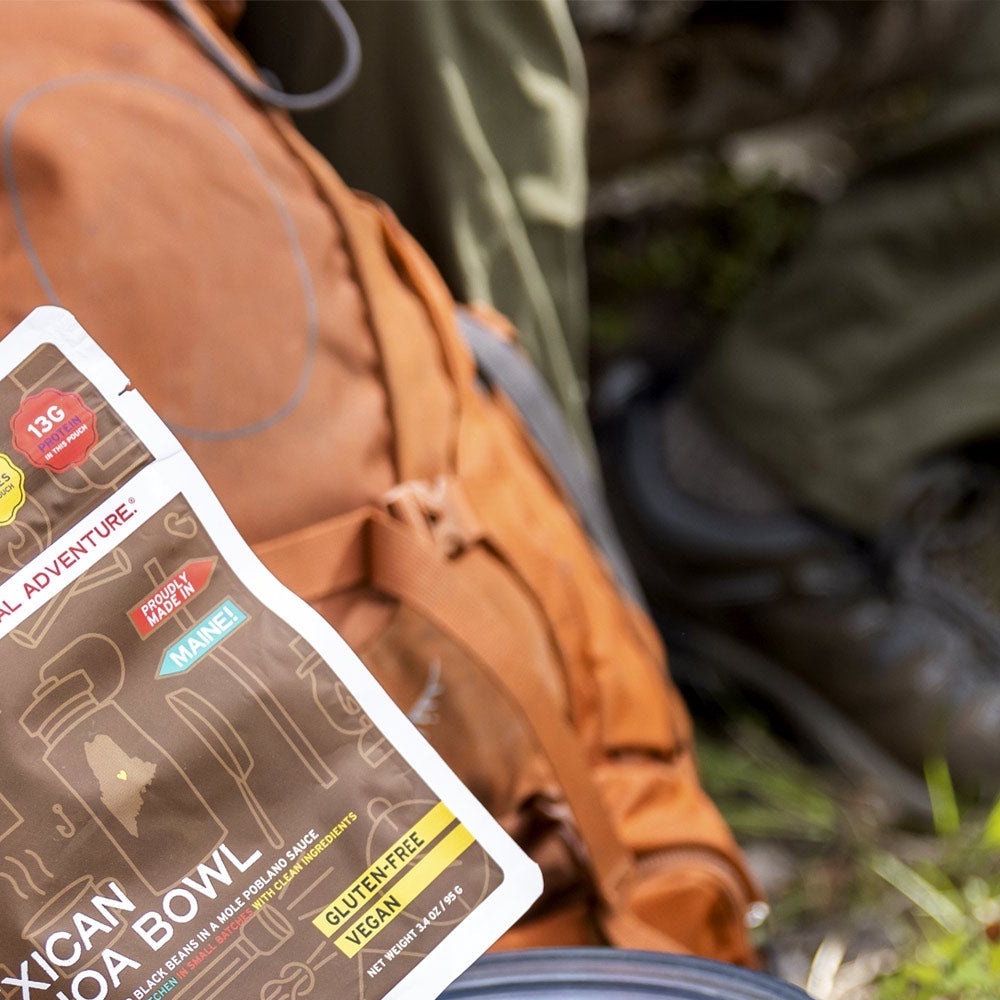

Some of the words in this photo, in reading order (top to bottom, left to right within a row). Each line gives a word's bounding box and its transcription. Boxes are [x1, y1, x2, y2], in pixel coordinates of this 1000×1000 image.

[27, 405, 65, 438] 13G
[37, 415, 82, 453] PROTEIN
[44, 452, 53, 461] IN
[52, 442, 68, 456] THIS
[66, 424, 88, 446] POUCH
[140, 571, 189, 617] PROUDLY
[146, 594, 182, 627] MADE
[180, 582, 195, 600] IN
[168, 605, 239, 668] MAINE!
[131, 843, 263, 951] BOWL
[176, 968, 188, 980] IN
[187, 943, 217, 970] SMALL
[214, 907, 255, 945] BATCHES
[251, 889, 276, 911] WITH
[273, 863, 303, 892] CLEAN
[300, 811, 358, 866] INGREDIENTS
[325, 831, 426, 926] GLUTEN-FREE
[133, 968, 169, 1000] BLACK
[165, 939, 200, 970] BEANS
[199, 931, 211, 943] IN
[210, 921, 220, 933] A
[216, 897, 246, 925] MOLE
[242, 857, 288, 901] POBLANO
[286, 828, 320, 861] SAUCE
[345, 895, 402, 946] VEGAN
[366, 958, 386, 979] NET
[384, 929, 418, 961] WEIGHT
[428, 906, 442, 921] OZ
[443, 890, 458, 905] 95
[455, 885, 465, 896] G
